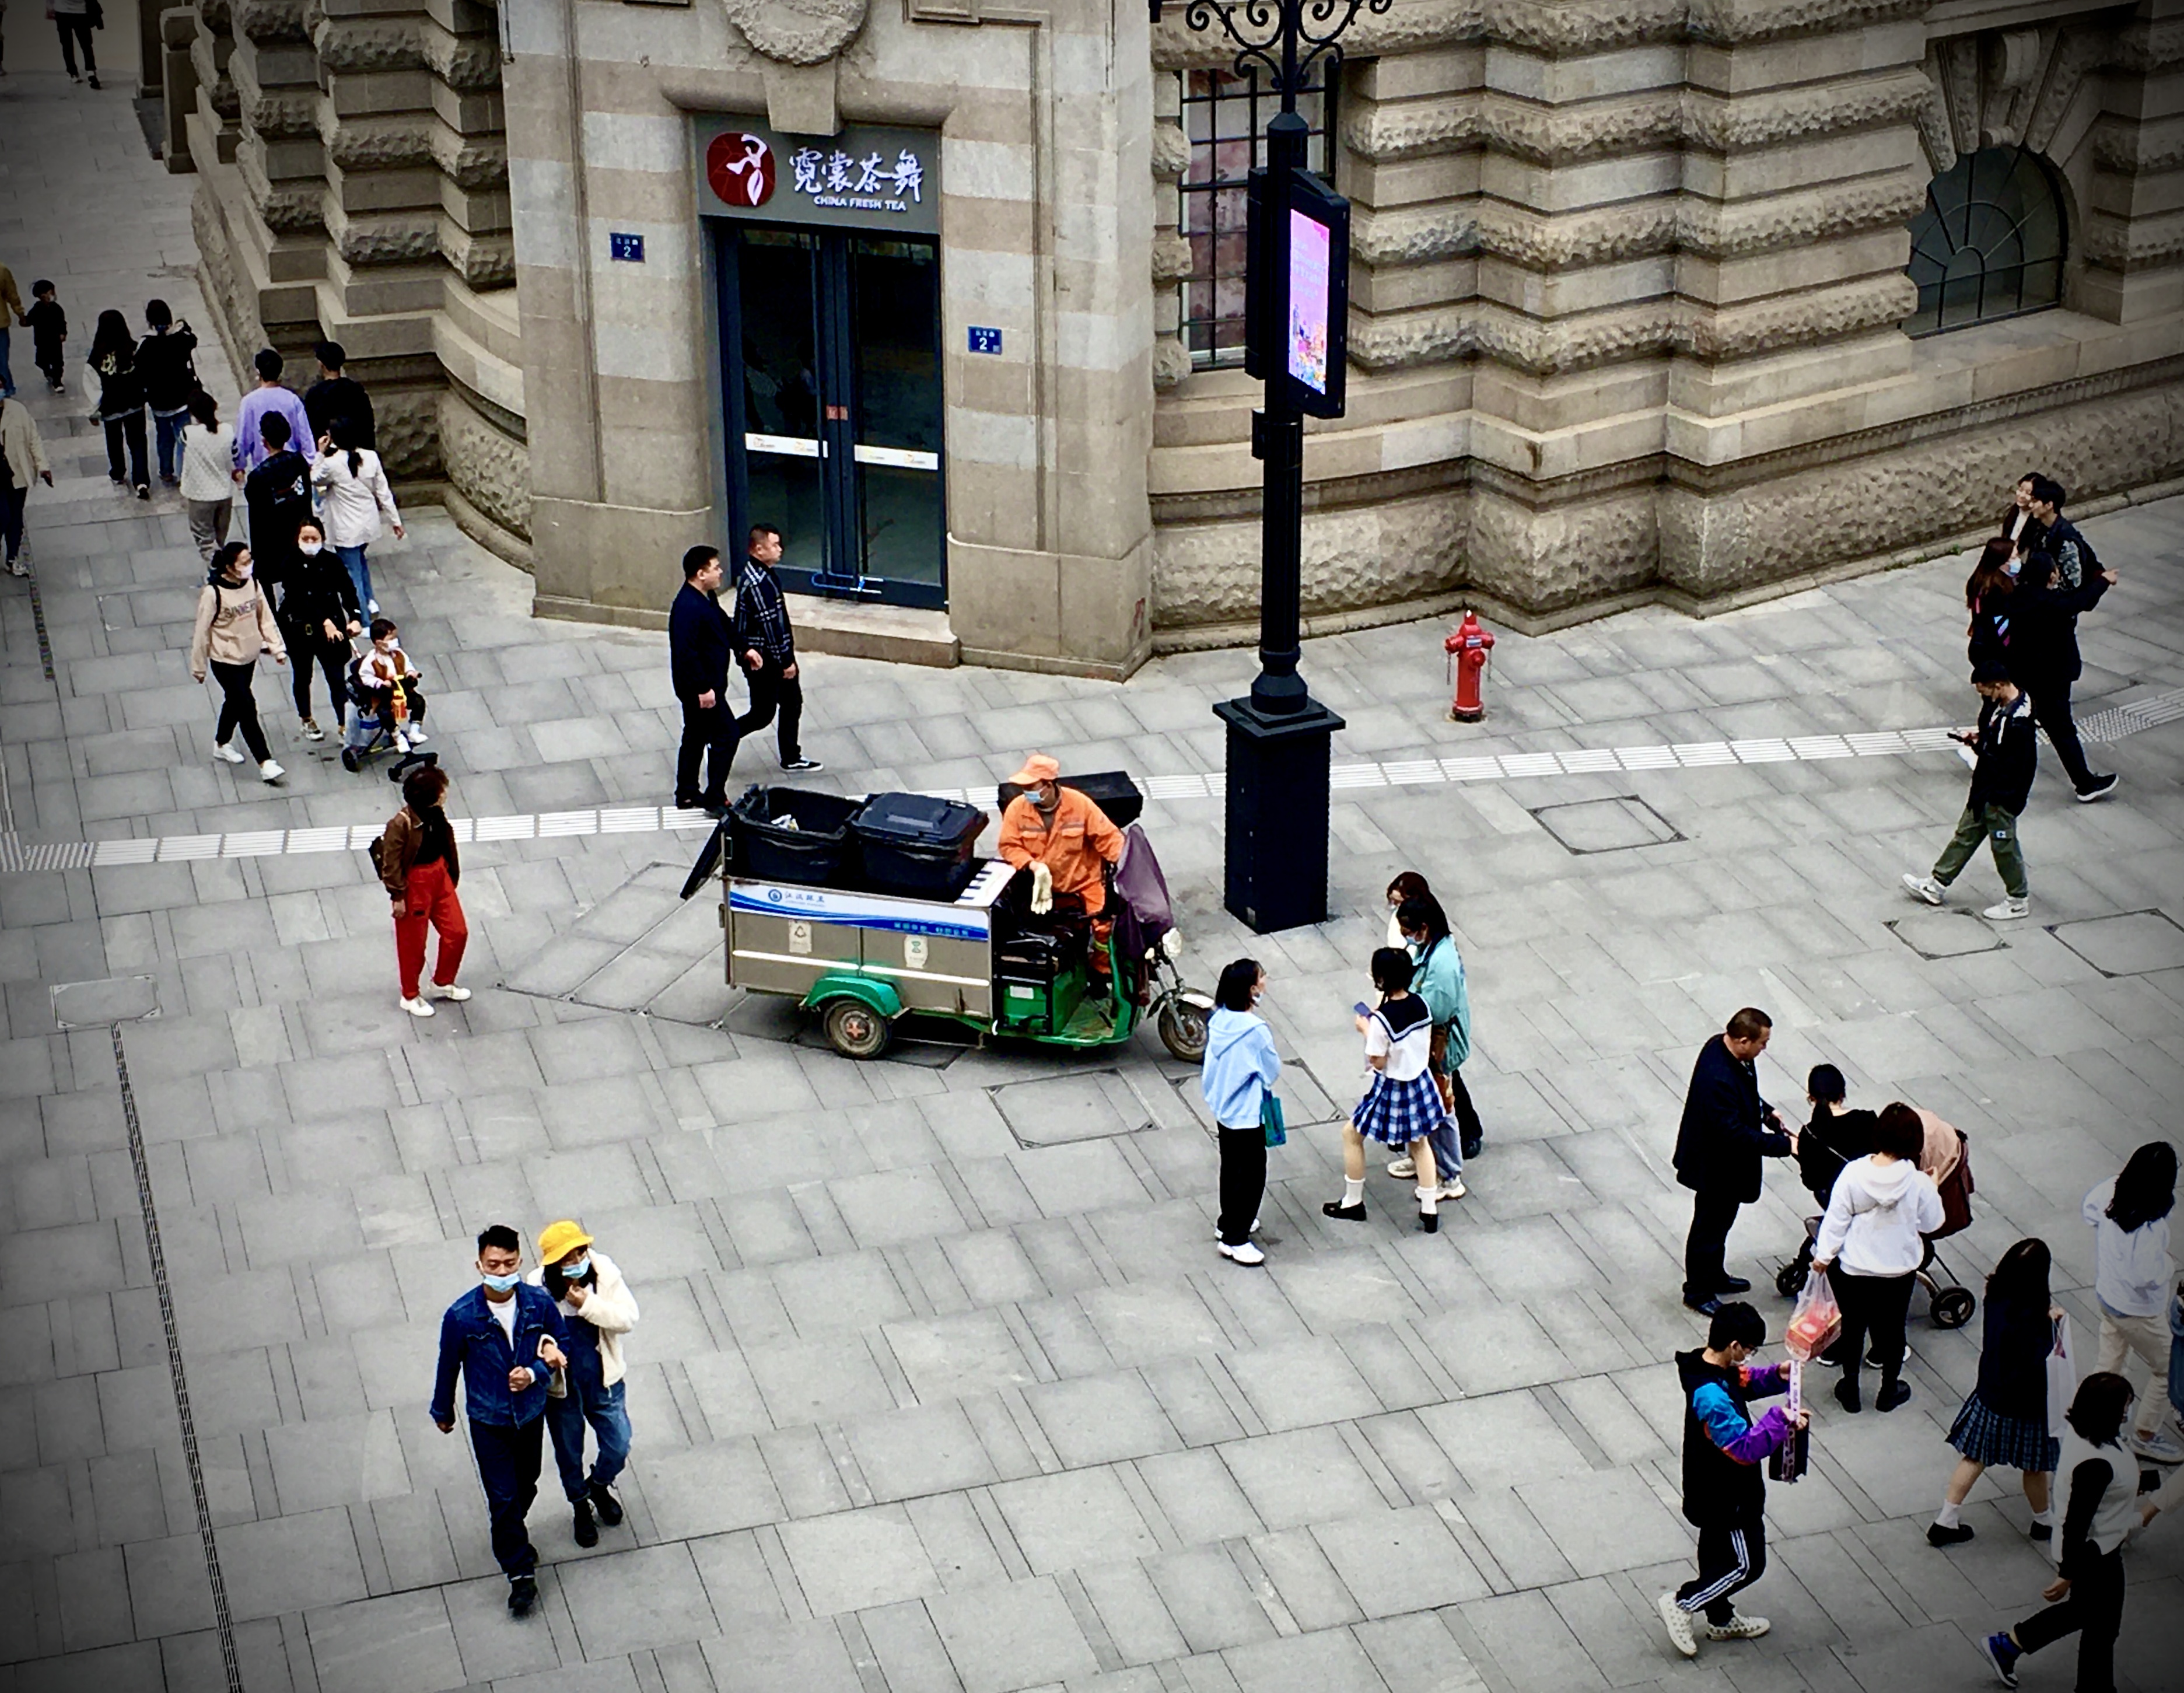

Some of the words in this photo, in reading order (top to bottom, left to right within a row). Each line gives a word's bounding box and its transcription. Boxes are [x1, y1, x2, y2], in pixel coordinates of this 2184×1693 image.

[789, 146, 923, 202] 霓裳茶舞
[814, 195, 847, 207] CHINA
[849, 197, 883, 209] FRESH
[884, 200, 907, 211] TEA
[624, 245, 631, 257] 2
[979, 337, 988, 350] 2
